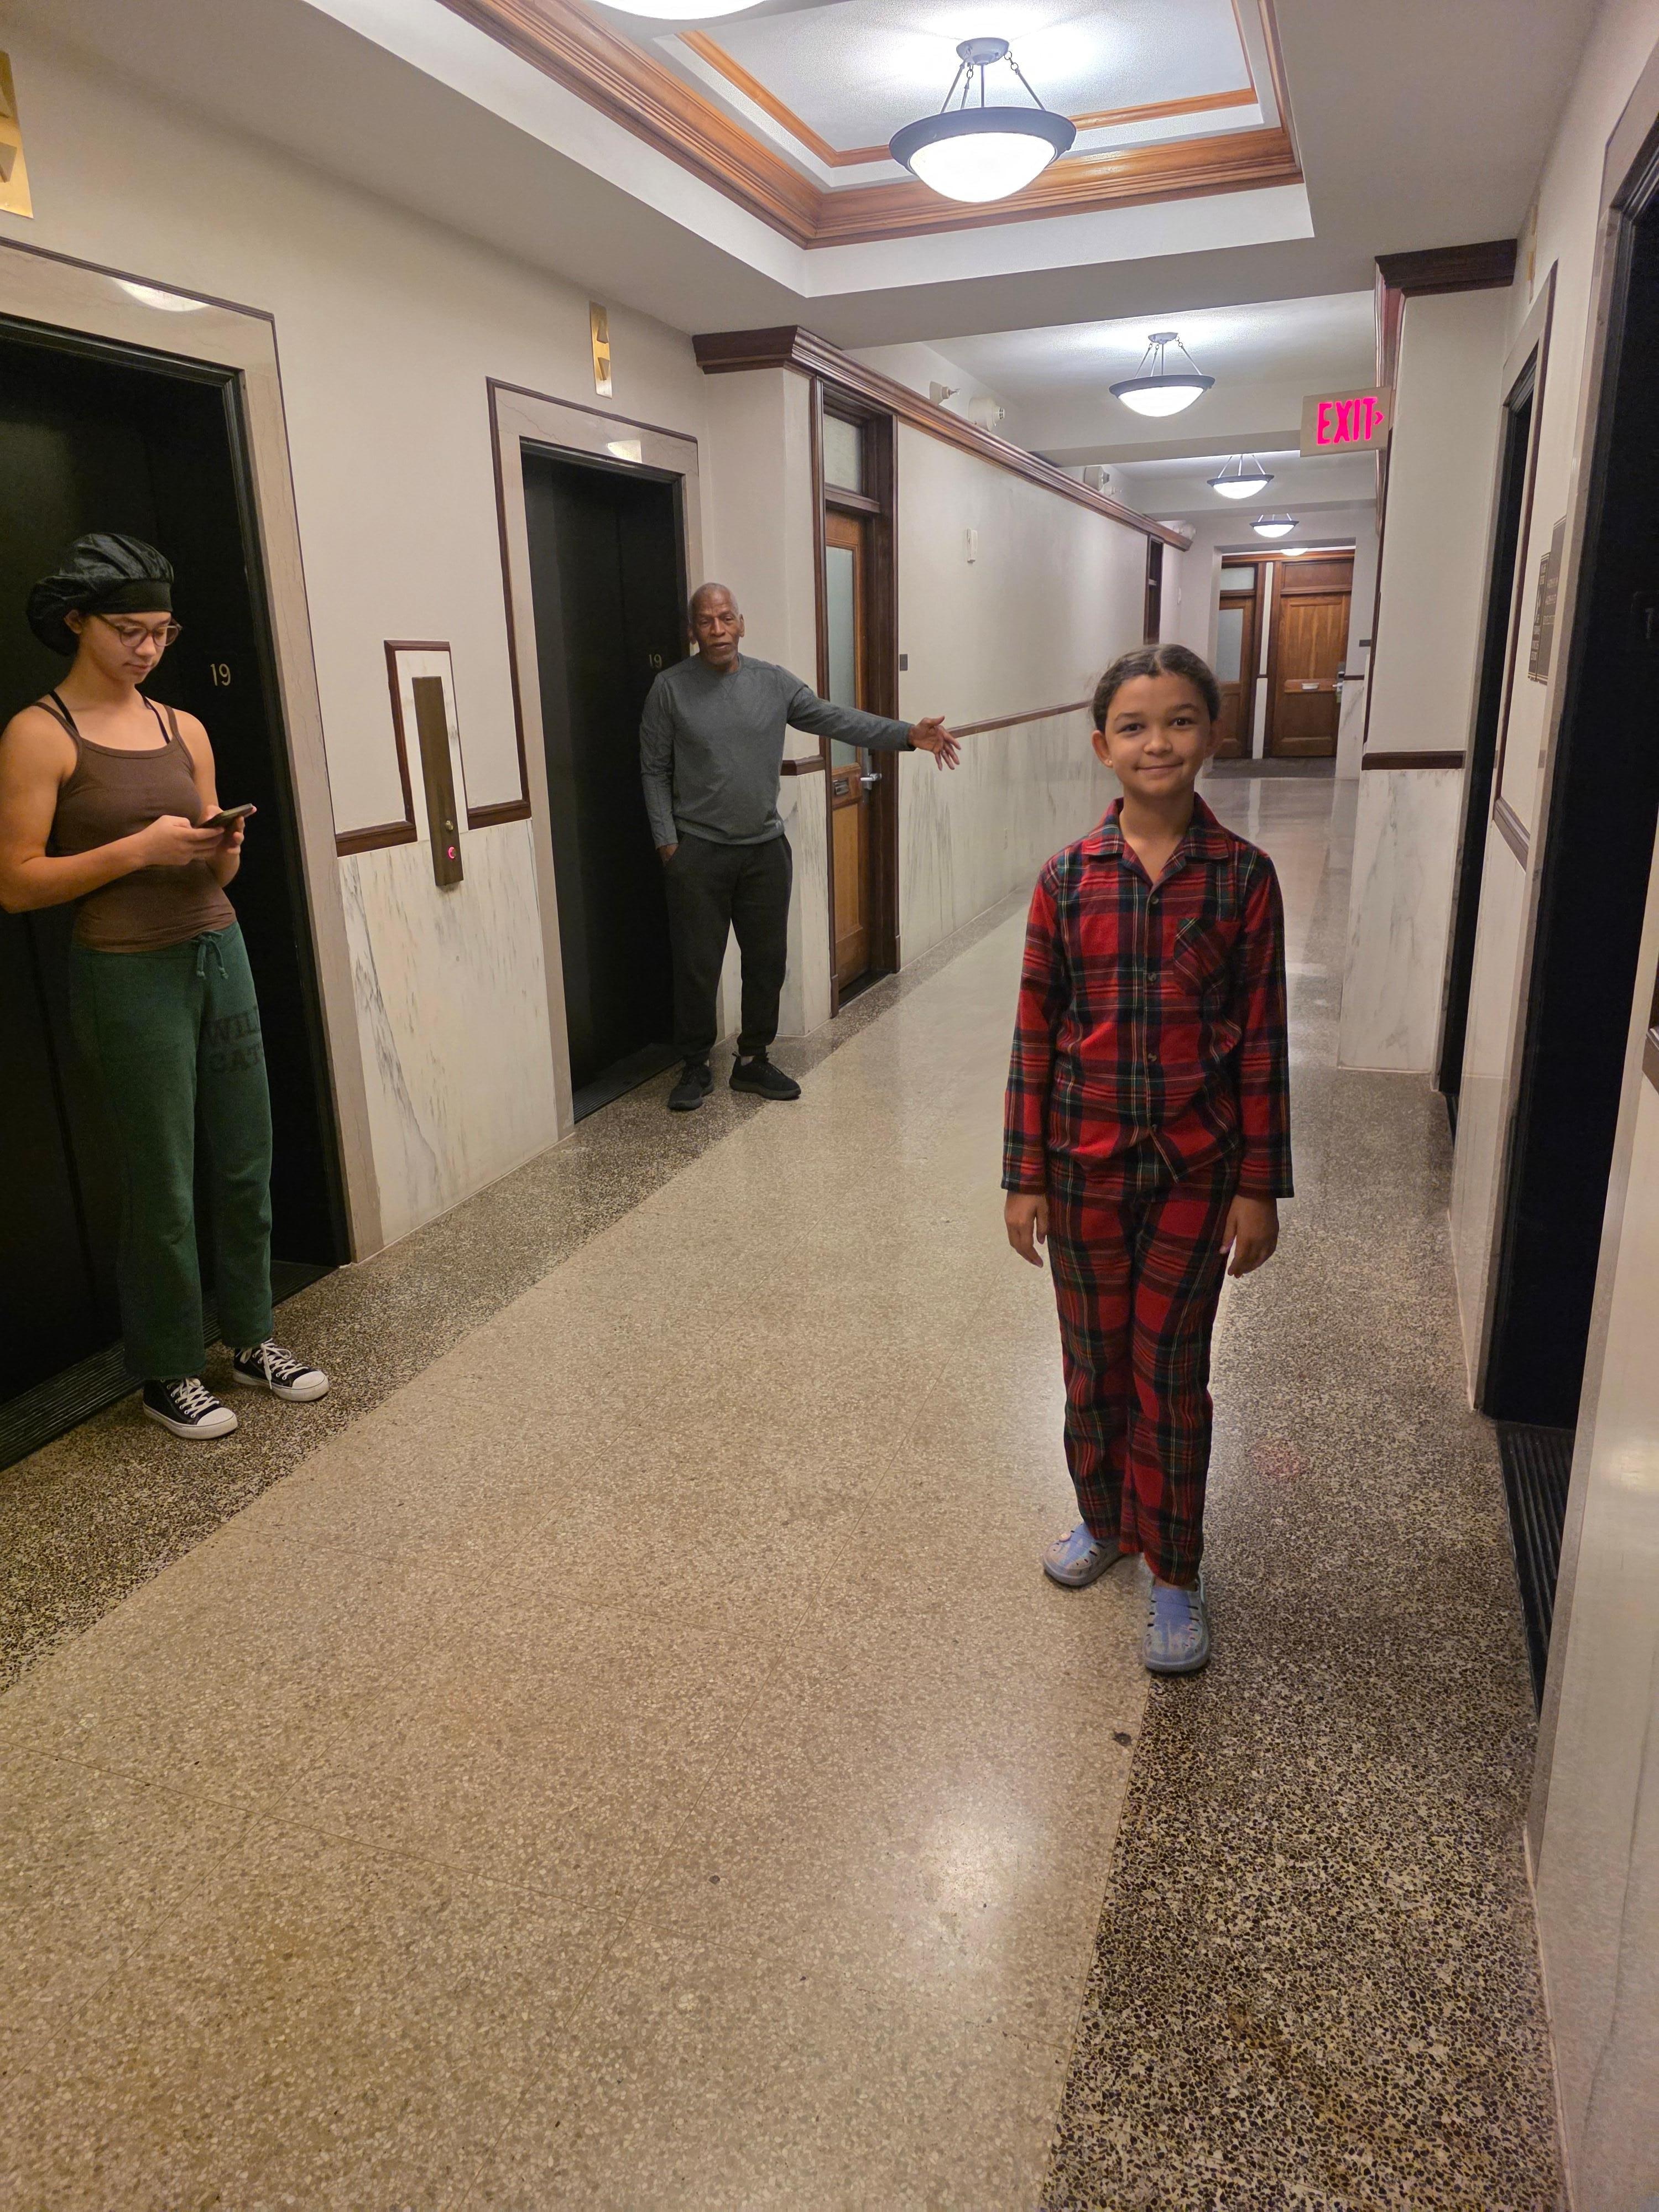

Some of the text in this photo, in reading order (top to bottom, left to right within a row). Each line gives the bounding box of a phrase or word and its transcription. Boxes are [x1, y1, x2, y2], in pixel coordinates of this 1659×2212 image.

[1317, 397, 1378, 446] EXIT
[648, 654, 662, 669] 19
[210, 663, 231, 686] 19
